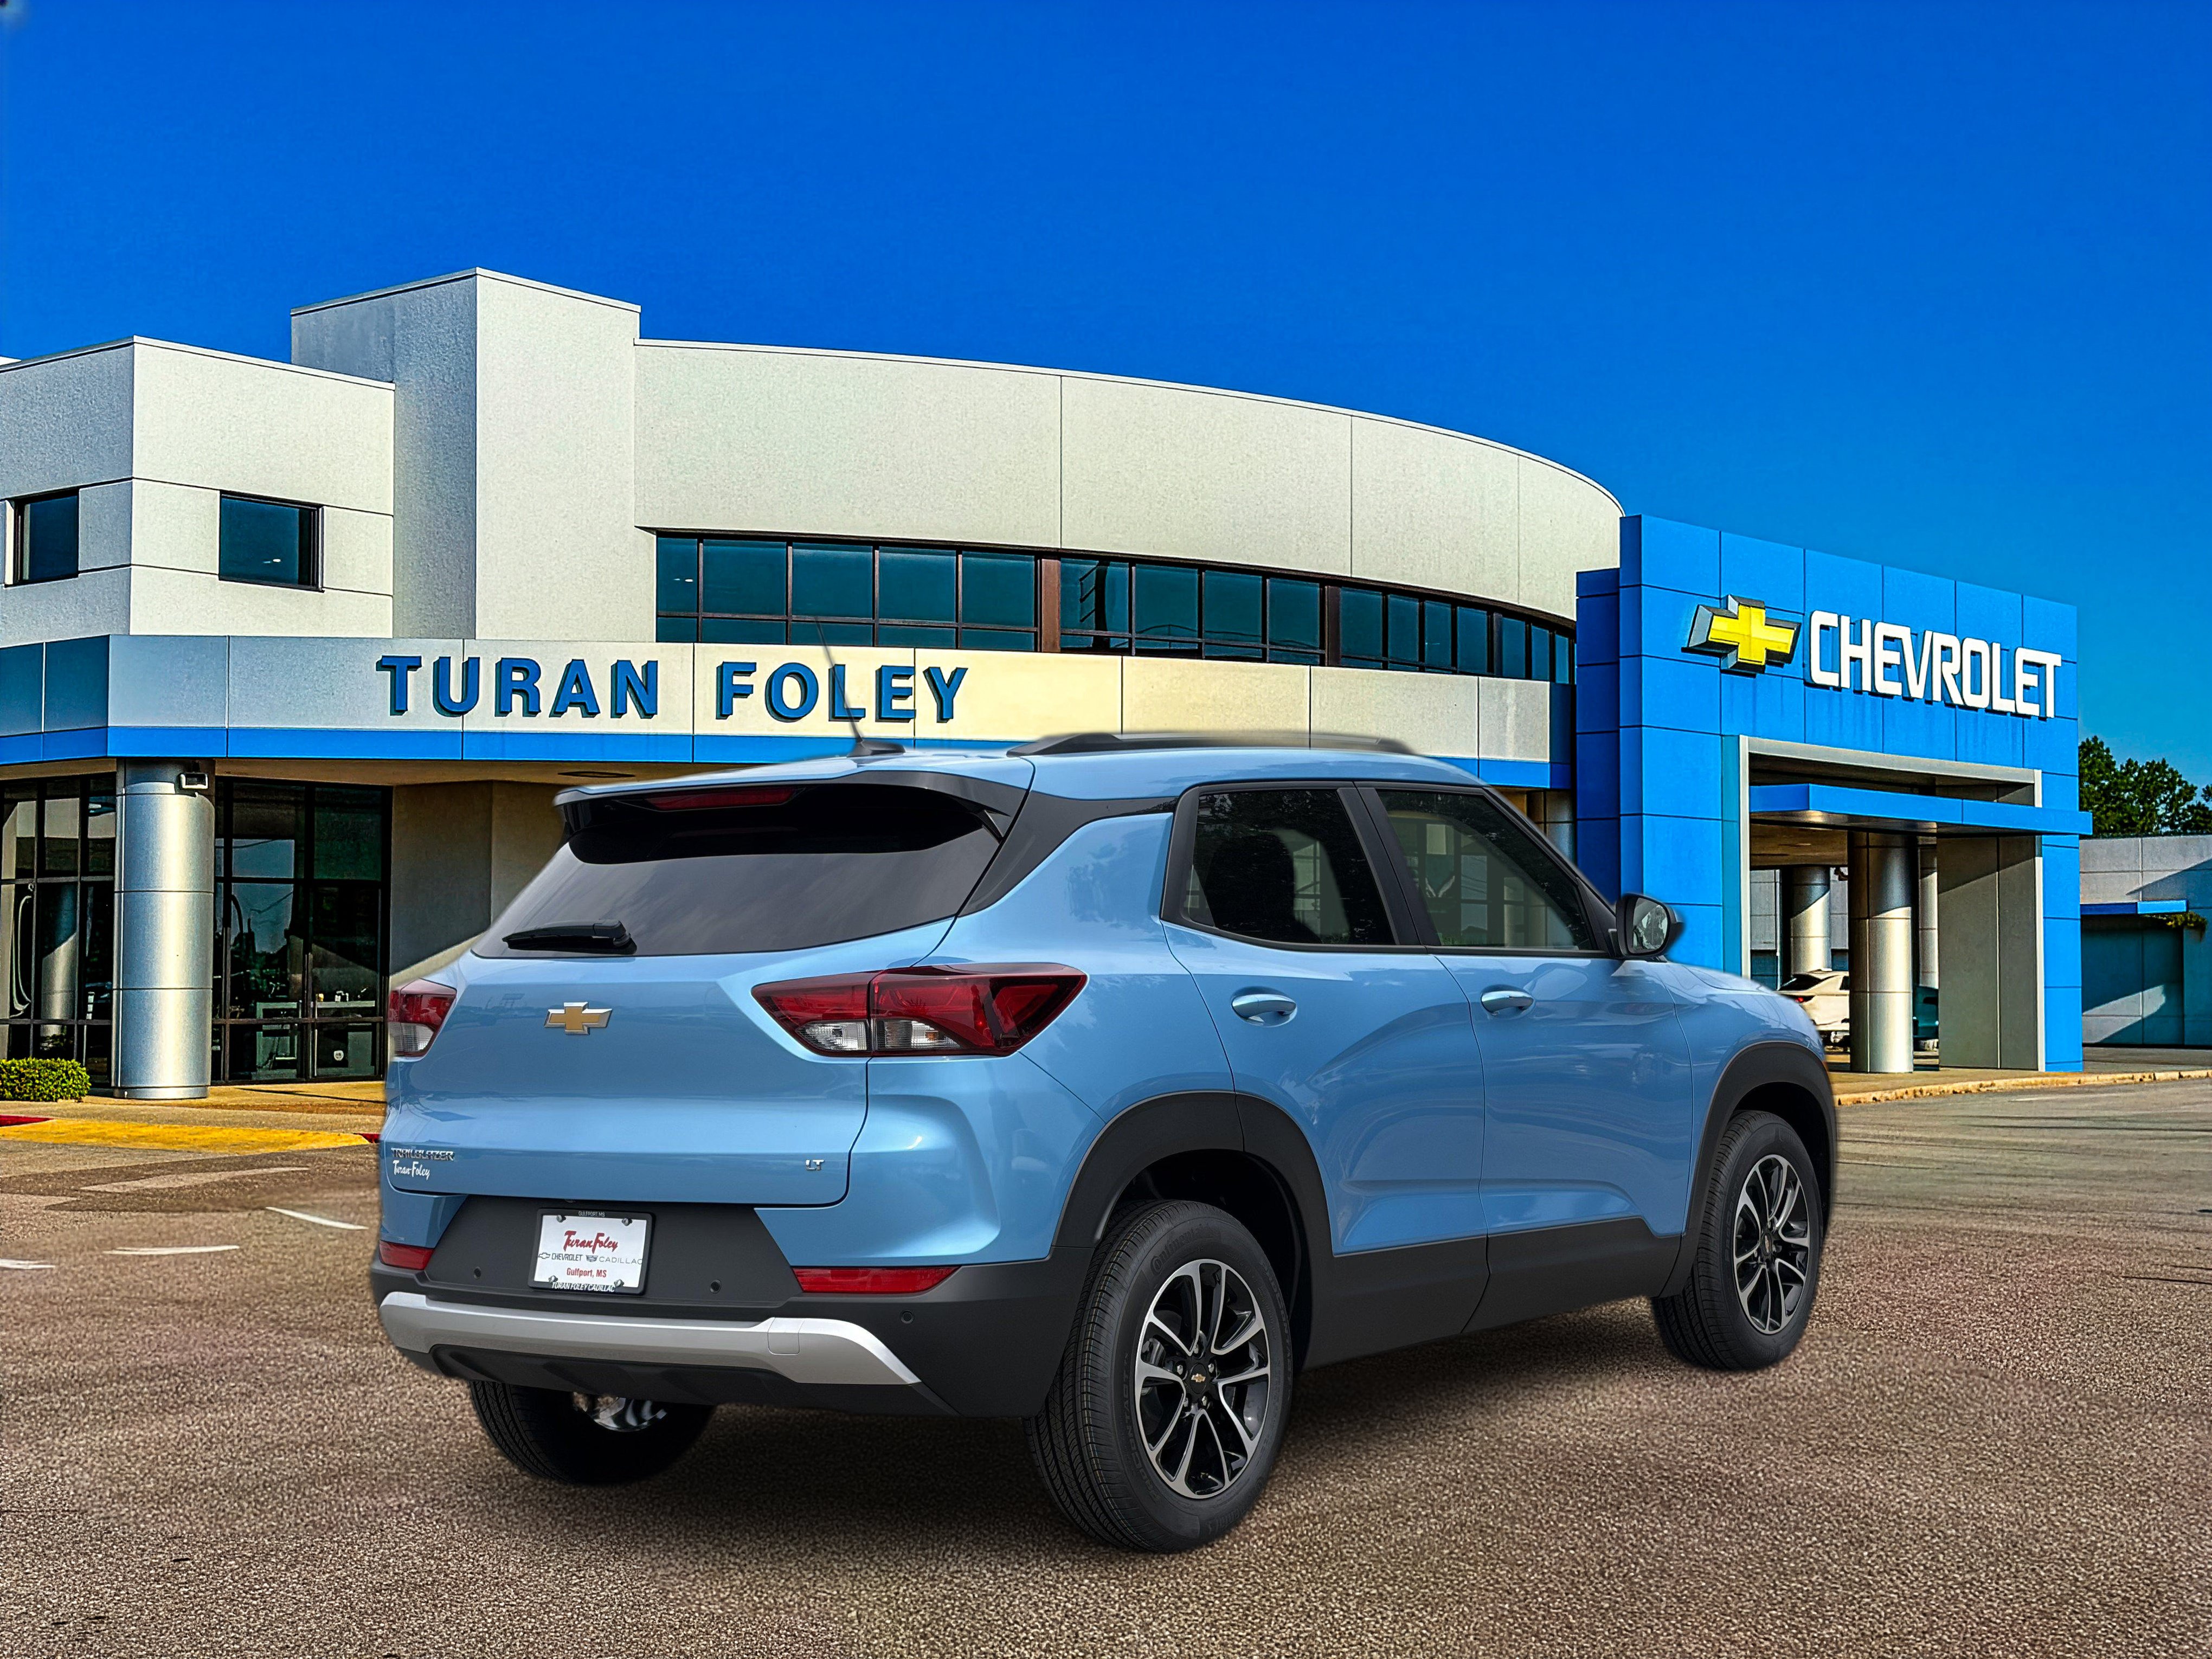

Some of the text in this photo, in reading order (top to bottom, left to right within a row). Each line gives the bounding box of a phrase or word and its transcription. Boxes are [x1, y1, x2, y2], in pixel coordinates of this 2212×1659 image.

[1810, 610, 2062, 718] CHEVROLET
[376, 655, 969, 723] TURAN FOLEY
[411, 1161, 430, 1181] Foley
[806, 1160, 825, 1171] LT
[563, 1230, 619, 1254] Turan Foley
[551, 1252, 583, 1262] CHEVROLET
[599, 1256, 642, 1265] CADILLAC
[567, 1267, 607, 1278] Gulfport, MS
[551, 1282, 570, 1290] TURAN
[588, 1284, 615, 1293] CADILLAC
